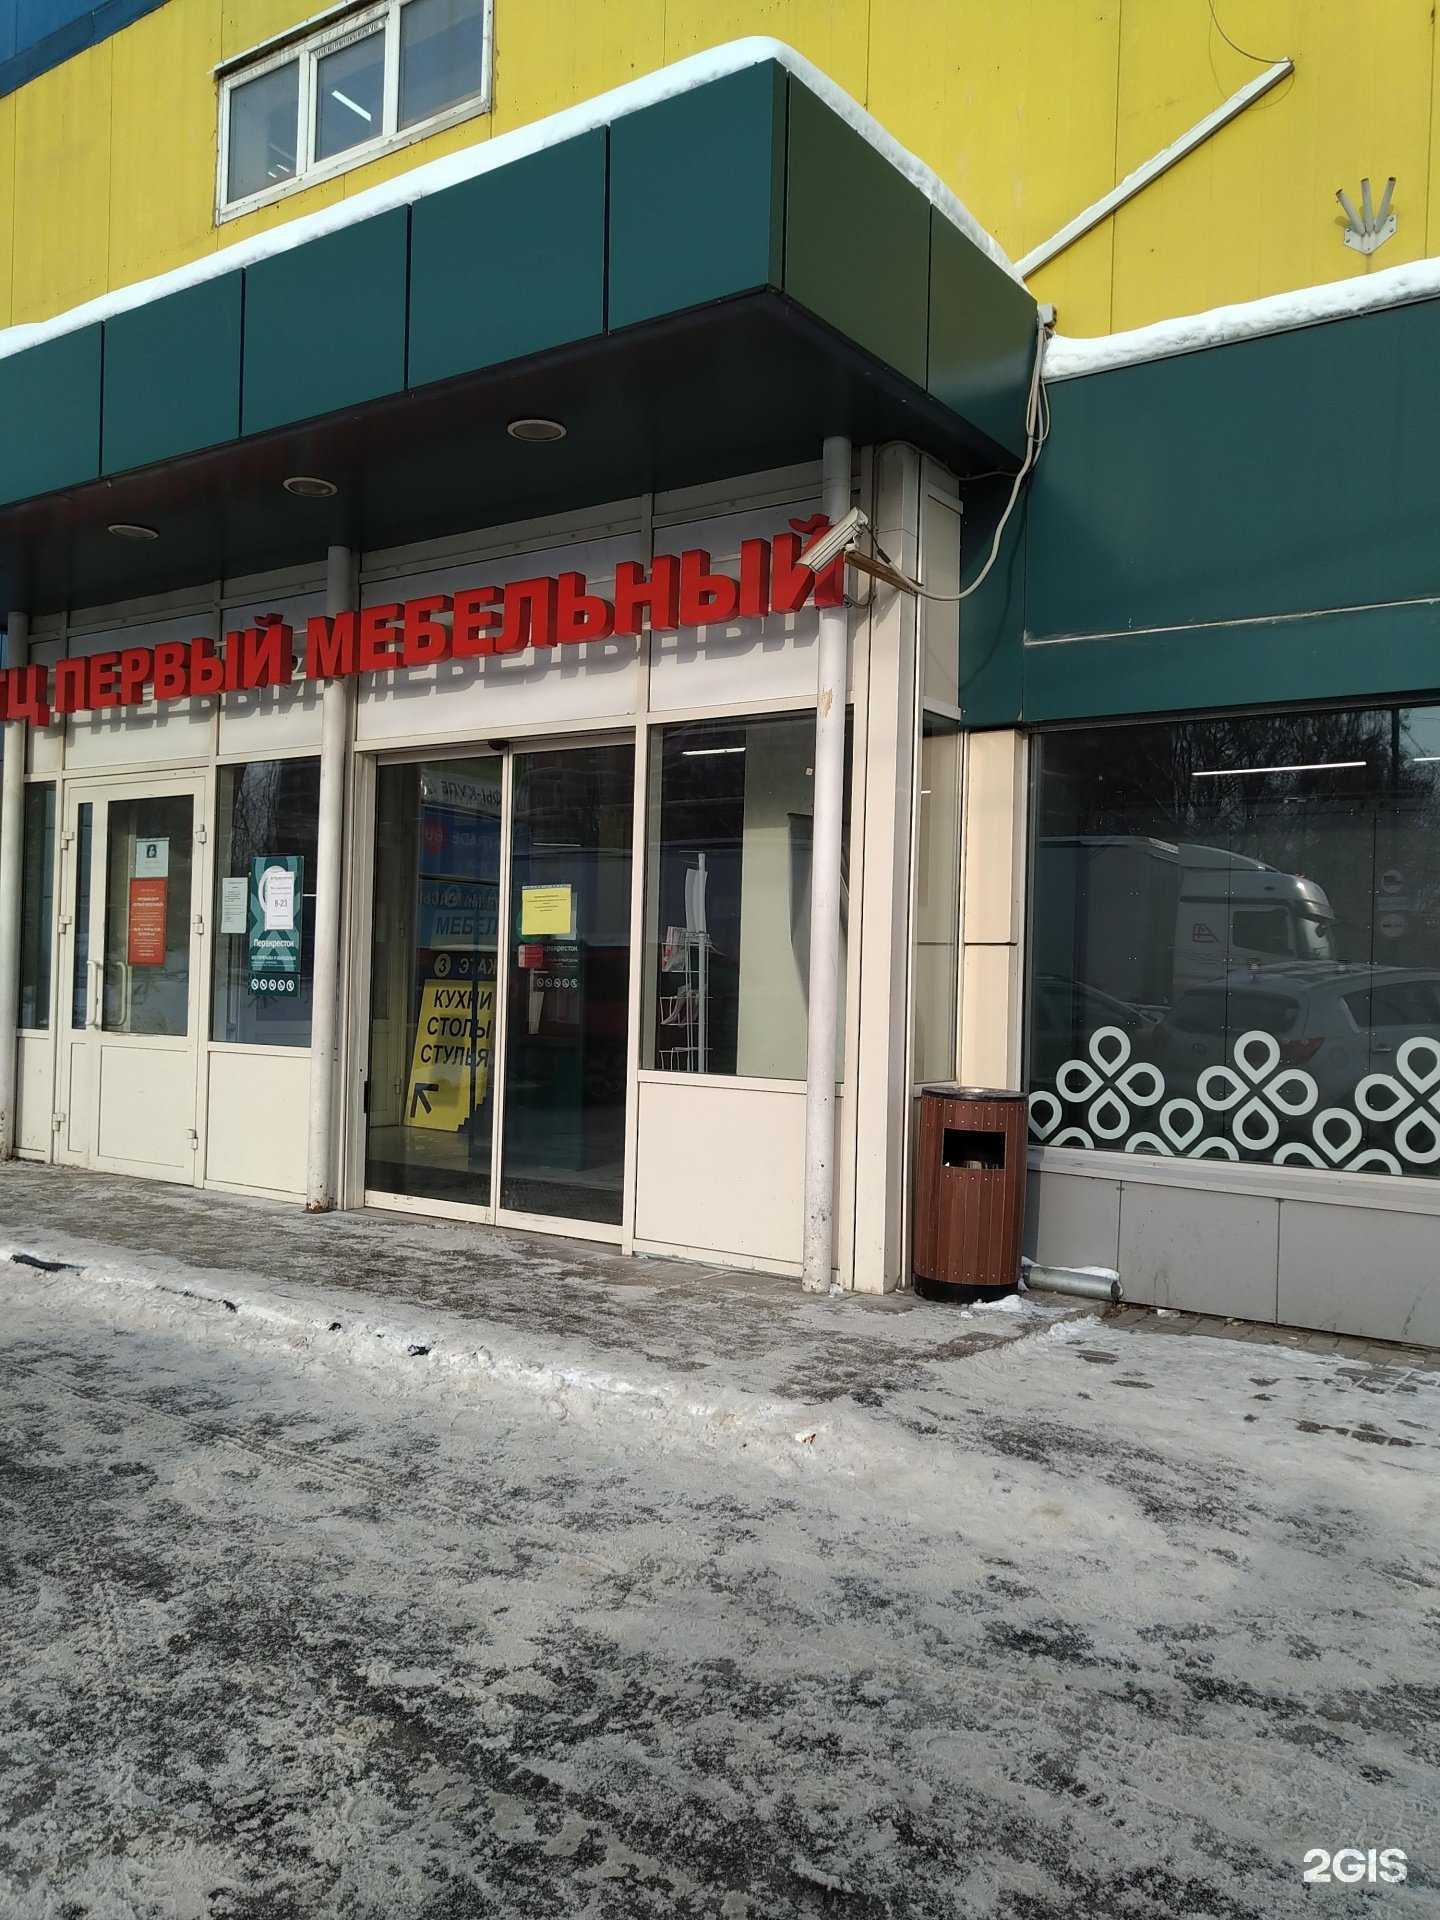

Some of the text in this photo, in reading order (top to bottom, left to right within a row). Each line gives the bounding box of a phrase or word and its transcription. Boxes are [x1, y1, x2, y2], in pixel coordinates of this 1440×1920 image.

[55, 613, 293, 714] ПЕРВЫЙ
[306, 513, 845, 679] МЕБЕЛЬНЫЙ
[253, 938, 295, 948] Перекресток
[433, 989, 493, 1011] КУХНИ
[427, 1016, 491, 1040] СТОЛЫ
[420, 1044, 488, 1068] СТУЛЬЯ
